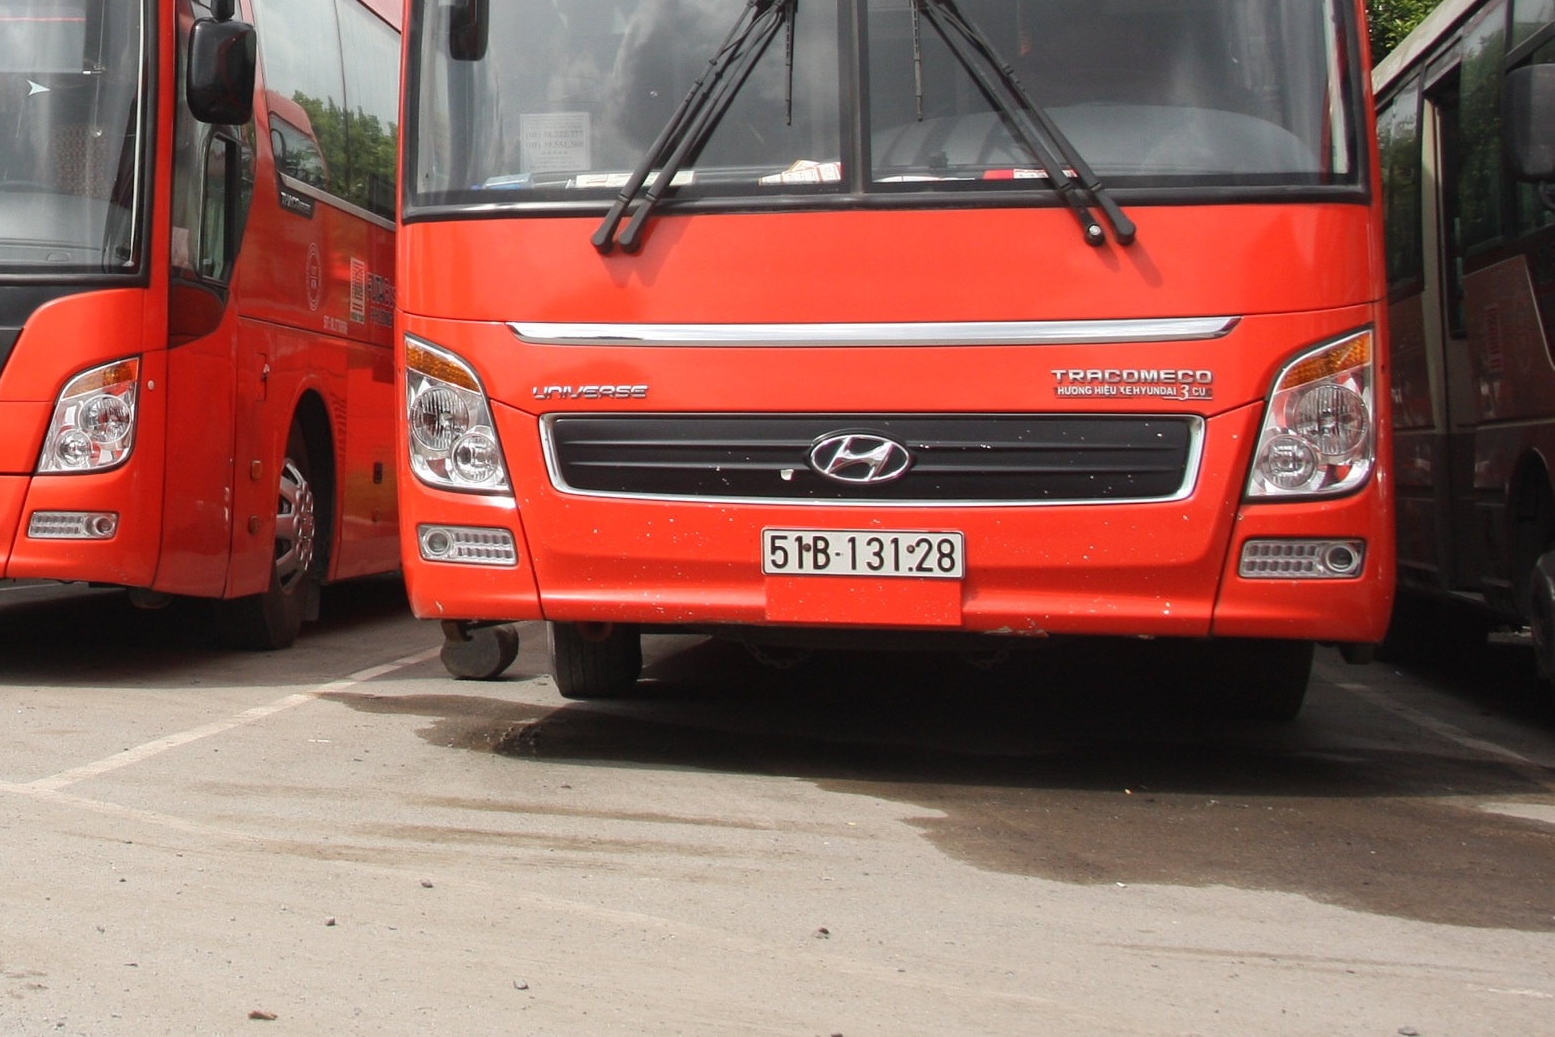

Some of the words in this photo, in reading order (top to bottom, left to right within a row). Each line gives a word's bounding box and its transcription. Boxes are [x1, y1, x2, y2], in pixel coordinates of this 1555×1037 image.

[1050, 369, 1214, 384] TRACOMECO
[532, 385, 649, 399] UNIVERSE
[1133, 386, 1177, 396] HYUNDAI
[1179, 384, 1189, 400] 3
[770, 534, 956, 574] 51B-131.28
